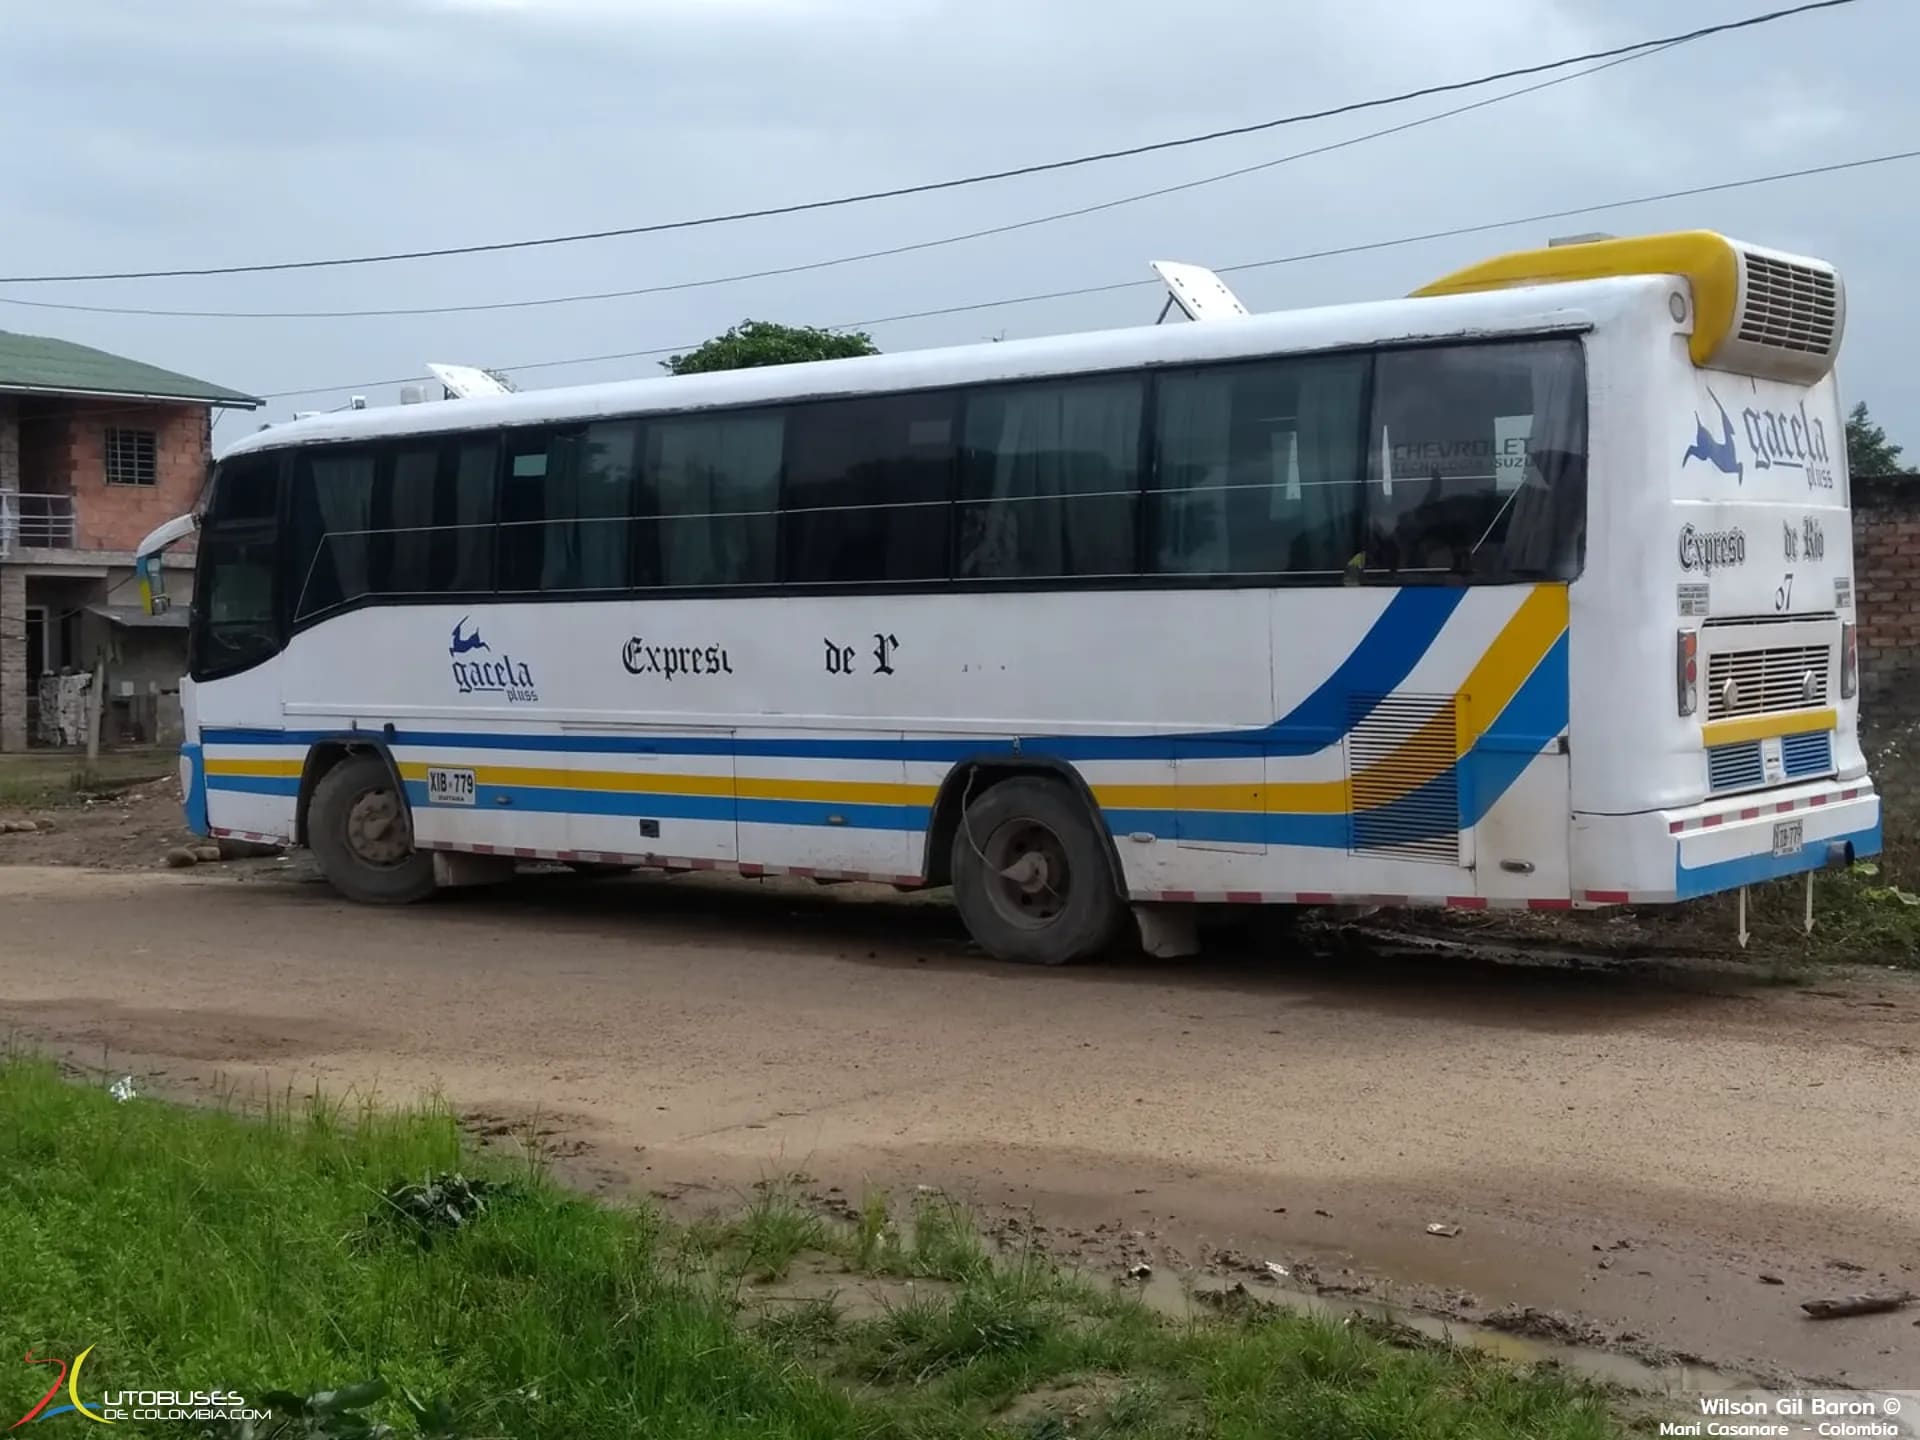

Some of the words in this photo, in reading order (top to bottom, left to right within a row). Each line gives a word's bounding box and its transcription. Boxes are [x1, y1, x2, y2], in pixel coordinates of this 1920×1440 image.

[1742, 399, 1829, 470] gacela
[1679, 522, 1746, 577] Expreso
[452, 655, 535, 693] gacela
[824, 637, 855, 675] de
[506, 687, 539, 703] pluss
